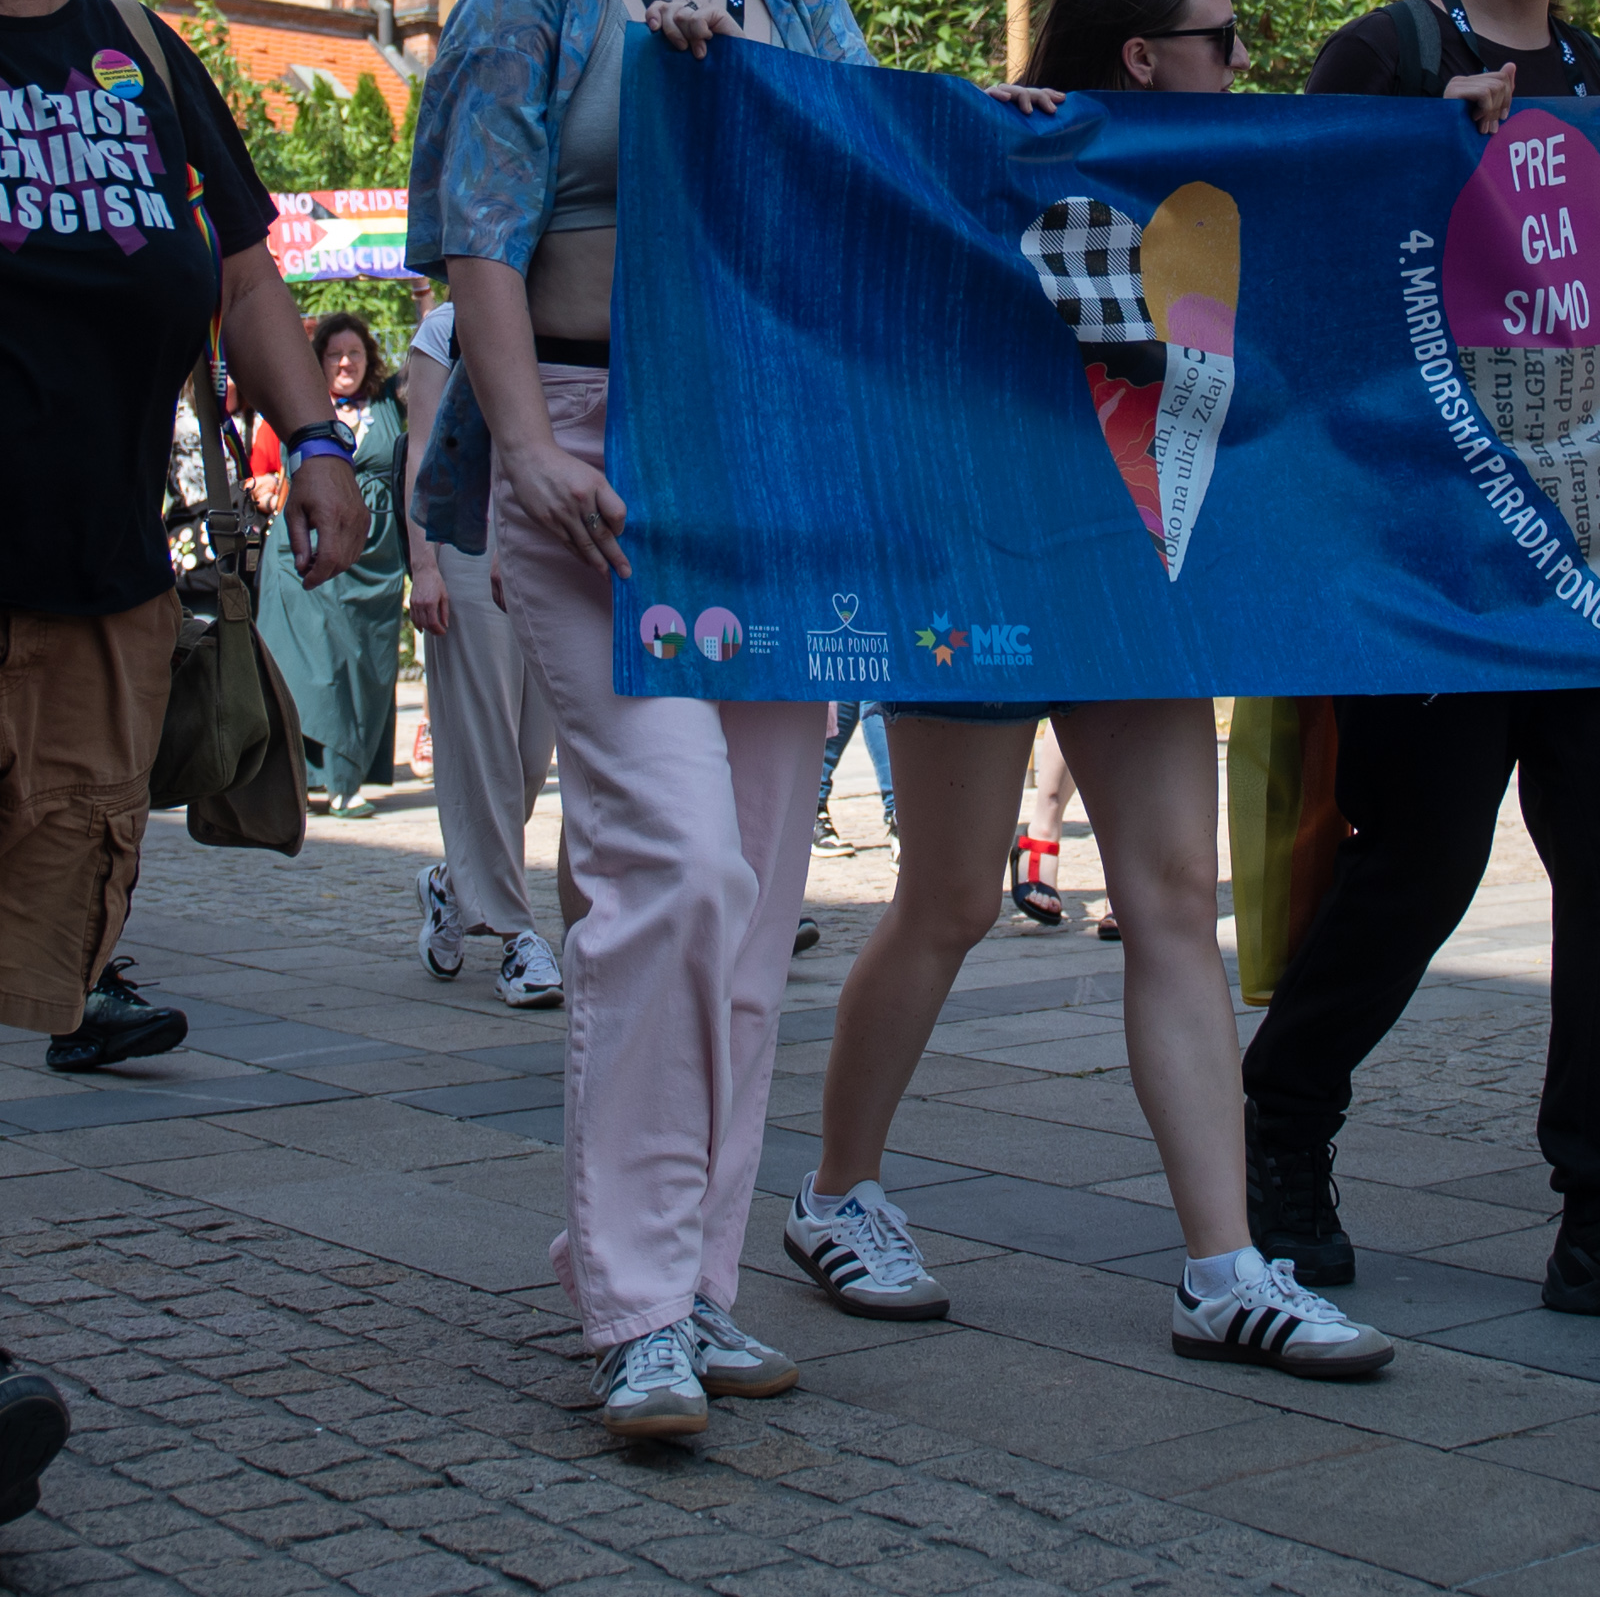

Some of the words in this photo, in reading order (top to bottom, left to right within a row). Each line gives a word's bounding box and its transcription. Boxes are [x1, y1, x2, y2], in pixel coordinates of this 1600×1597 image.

[1509, 132, 1566, 191] PRE
[277, 192, 314, 215] NO
[334, 188, 408, 214] PRIDE
[281, 222, 312, 243] IN
[1398, 229, 1435, 265] 4.
[1521, 206, 1578, 265] GLA
[1503, 280, 1590, 336] SIMO
[1400, 265, 1493, 474] MARIBORSKA
[1161, 366, 1200, 421] kako
[1192, 375, 1228, 425] Zdaj
[1576, 399, 1595, 425] še
[1556, 418, 1576, 448] na
[1175, 428, 1204, 484] ulici.
[1172, 485, 1189, 514] na
[1478, 454, 1563, 571] PARADA
[806, 634, 844, 653] PARADA
[847, 636, 890, 653] PONOSA
[971, 624, 1033, 655] MKC
[807, 653, 891, 683] MARIBOR
[973, 654, 1034, 667] MARIBOR
